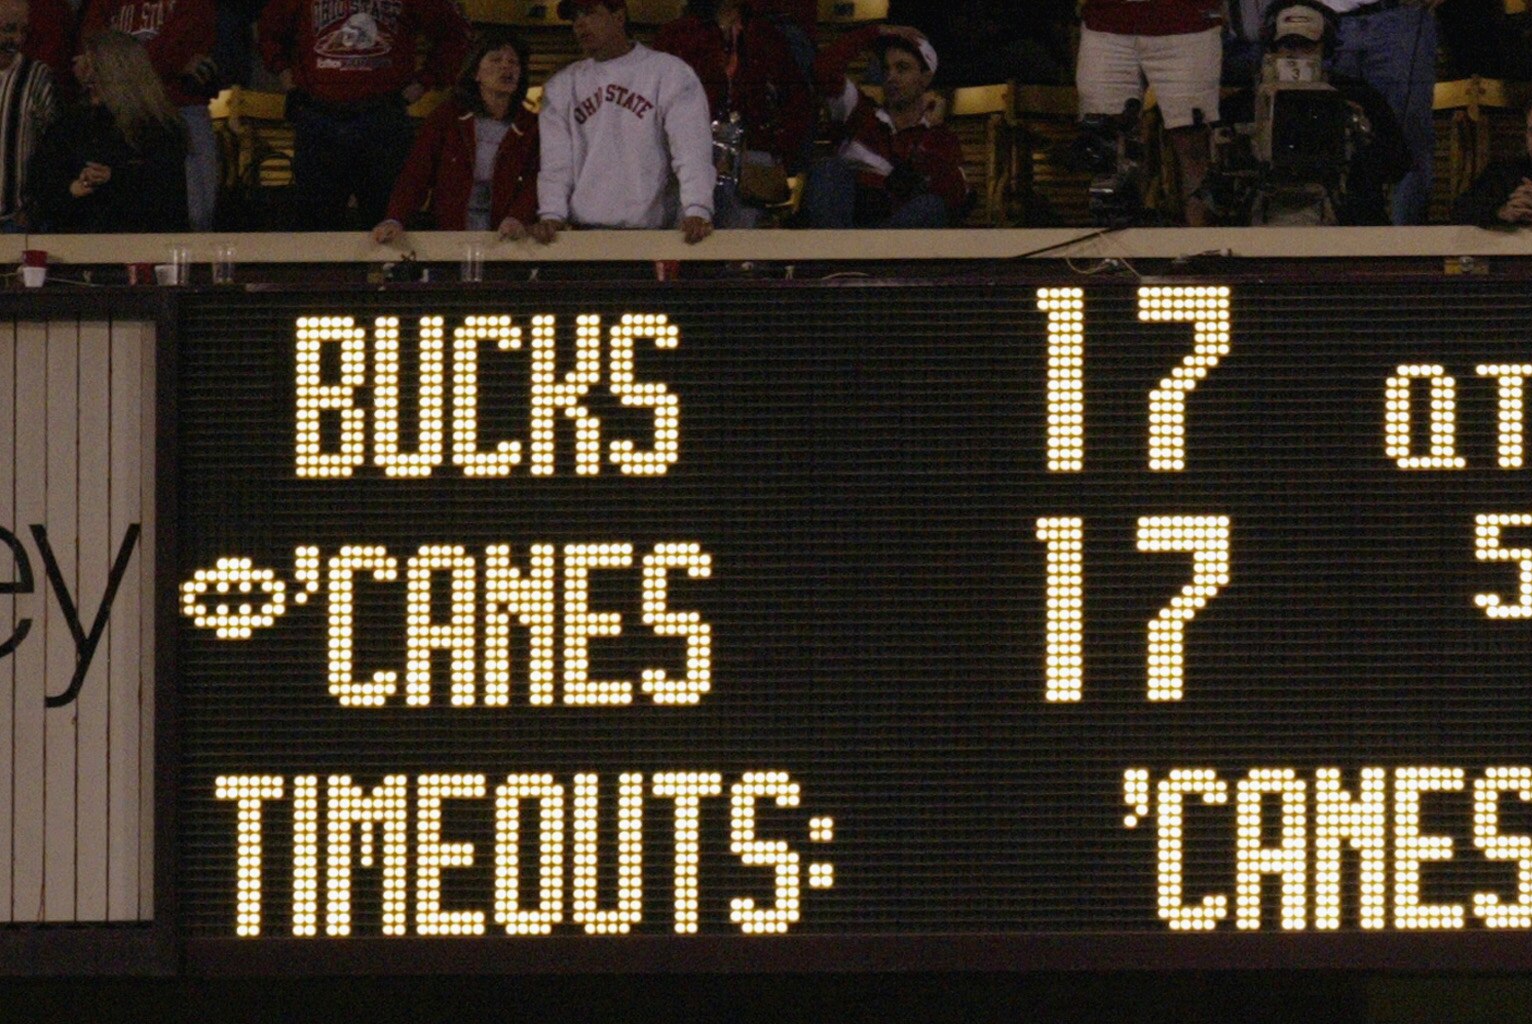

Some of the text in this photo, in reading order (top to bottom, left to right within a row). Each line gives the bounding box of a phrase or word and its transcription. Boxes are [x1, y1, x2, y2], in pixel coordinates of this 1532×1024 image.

[605, 83, 654, 120] STATE
[295, 287, 1230, 477] BUCKS 17
[294, 515, 1230, 706] 'CANES 17
[215, 771, 834, 937] TIMEOUTS:
